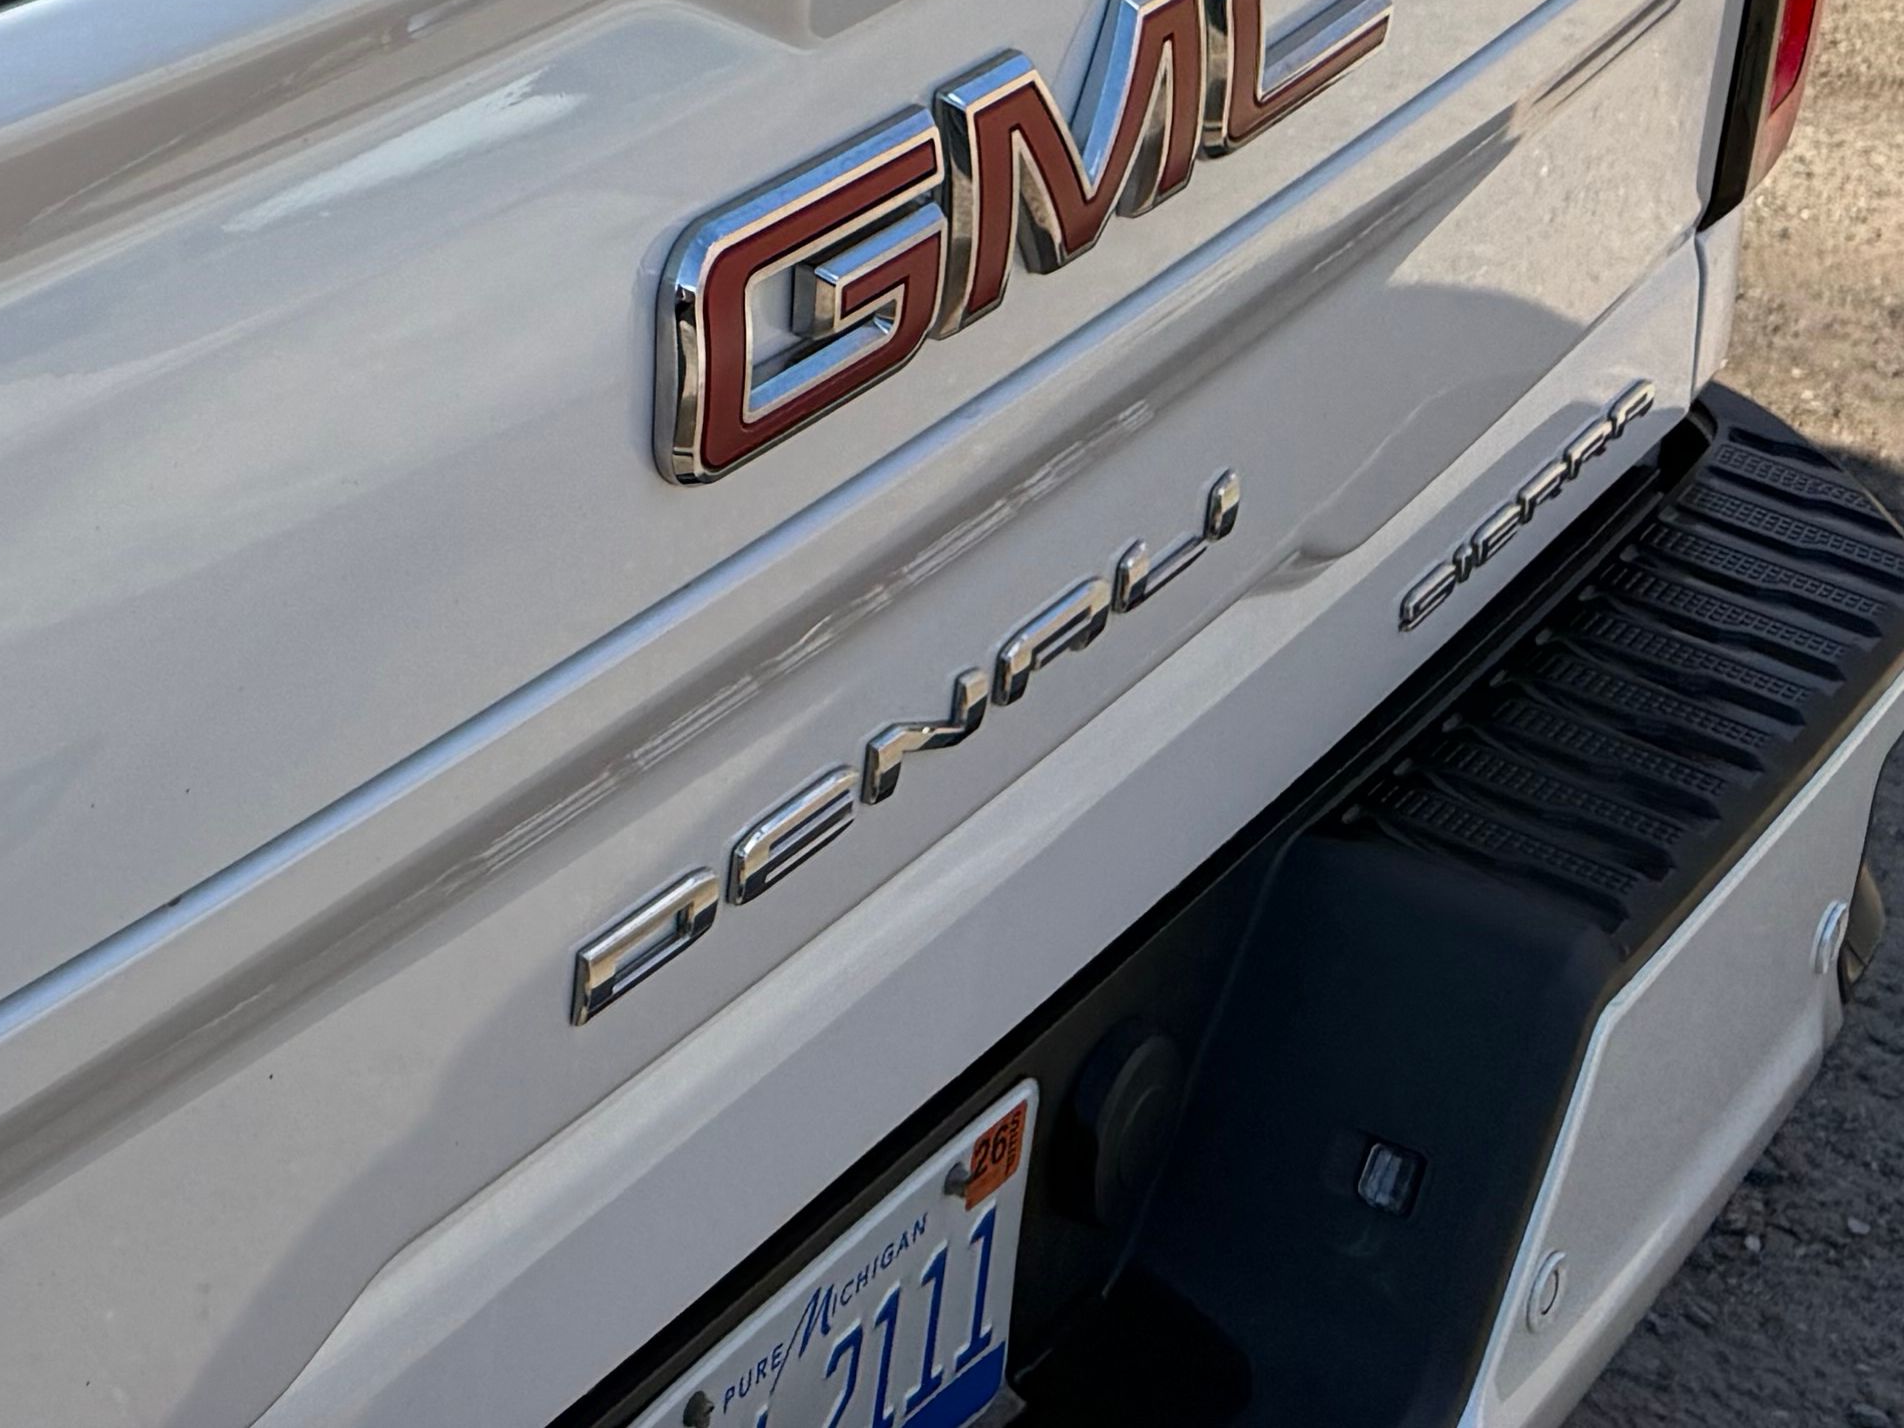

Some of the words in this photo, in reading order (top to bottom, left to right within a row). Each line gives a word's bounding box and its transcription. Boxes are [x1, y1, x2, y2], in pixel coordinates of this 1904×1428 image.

[1398, 378, 1655, 632] SIERRA
[570, 468, 1240, 1026] DENALI
[972, 1124, 1009, 1180] 26
[723, 1343, 784, 1414] PURE
[769, 1211, 929, 1398] MICHIGAN
